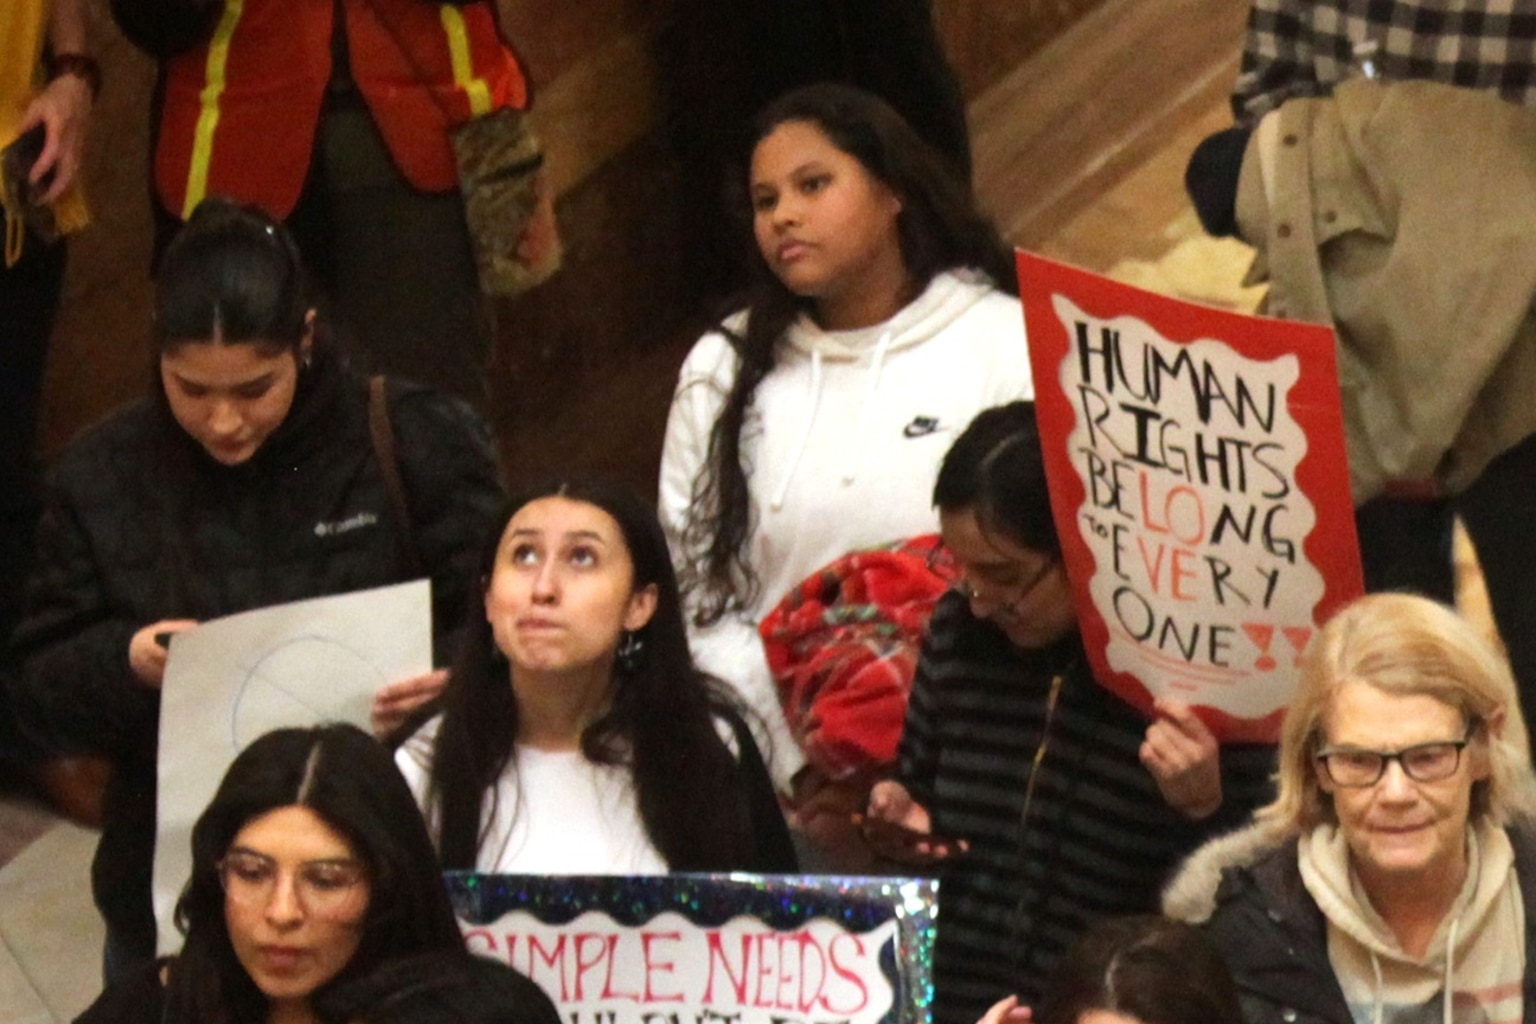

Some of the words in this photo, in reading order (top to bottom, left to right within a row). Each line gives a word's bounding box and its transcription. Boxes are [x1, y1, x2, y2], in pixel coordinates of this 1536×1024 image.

[1074, 320, 1276, 434] HUMAN
[1077, 384, 1290, 500] RIGHTS
[1078, 447, 1296, 565] BELONG
[1112, 522, 1281, 610] EVERY
[702, 930, 870, 1016] NEEDS
